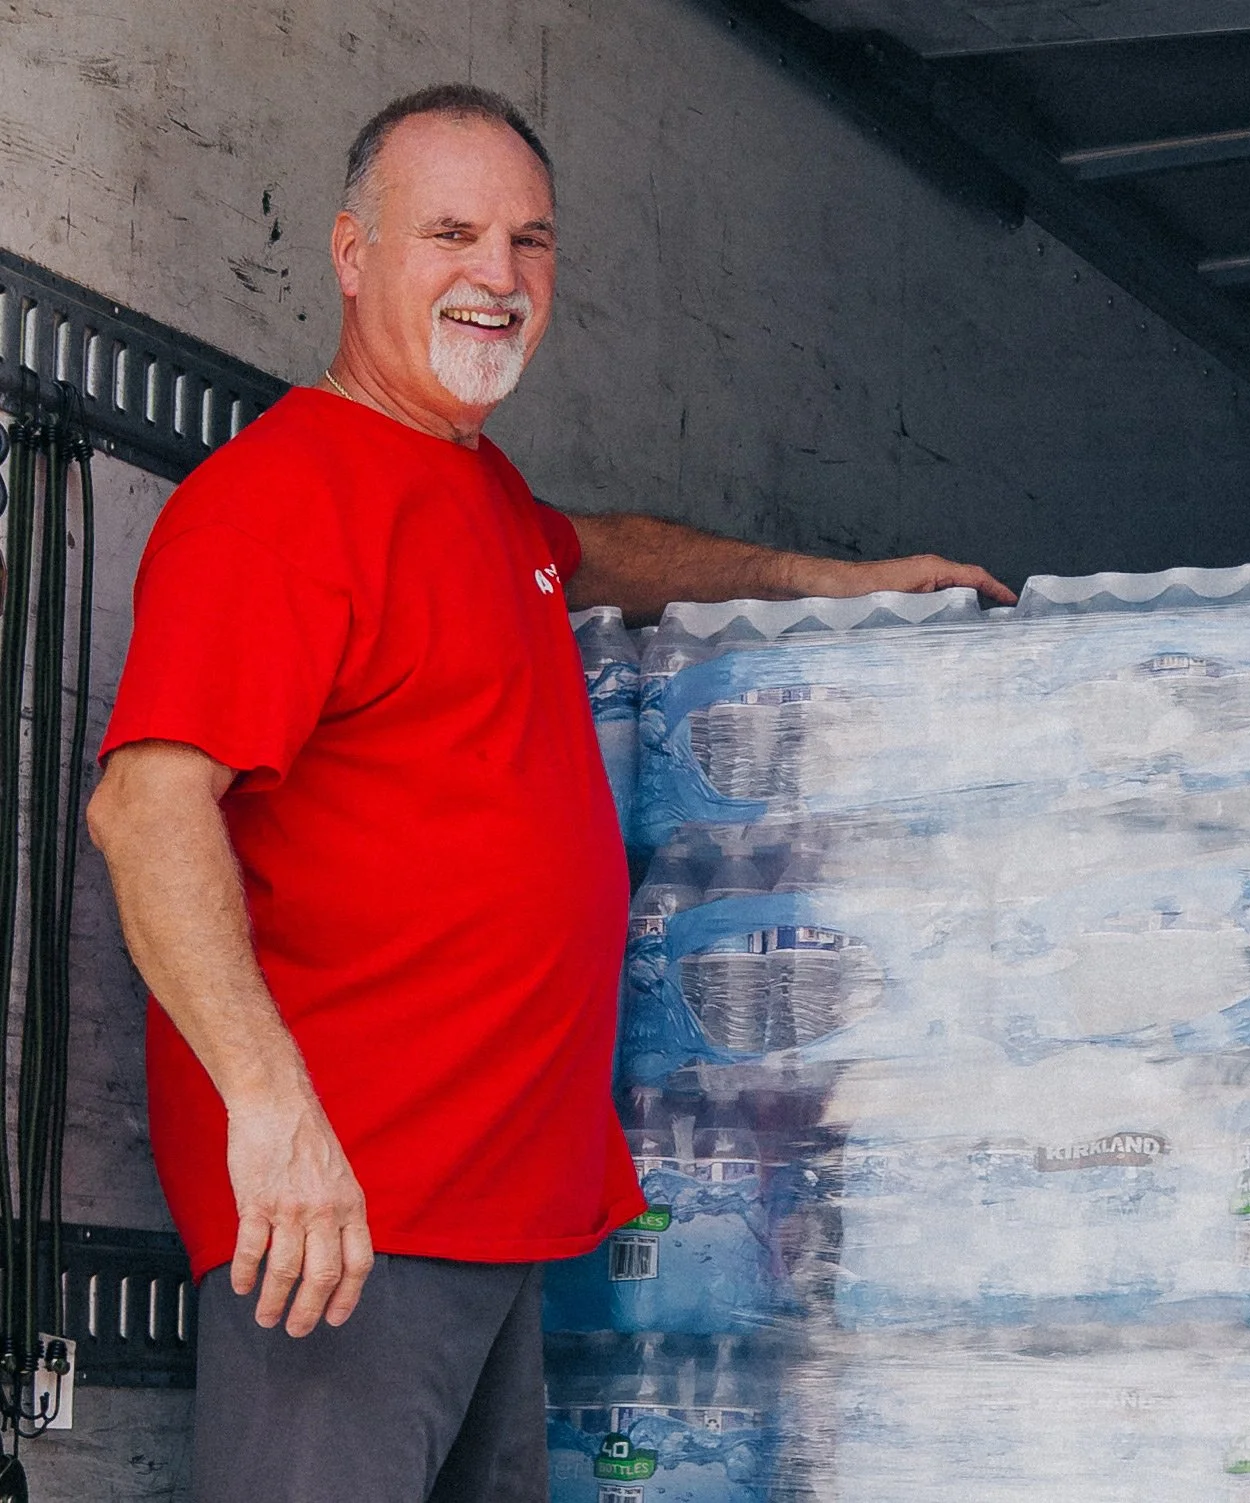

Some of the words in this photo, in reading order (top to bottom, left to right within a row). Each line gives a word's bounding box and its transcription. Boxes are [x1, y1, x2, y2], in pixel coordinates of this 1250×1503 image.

[1044, 1135, 1161, 1161] KIRKLAND
[602, 1441, 630, 1458] 40
[599, 1462, 650, 1476] BOTTLES
